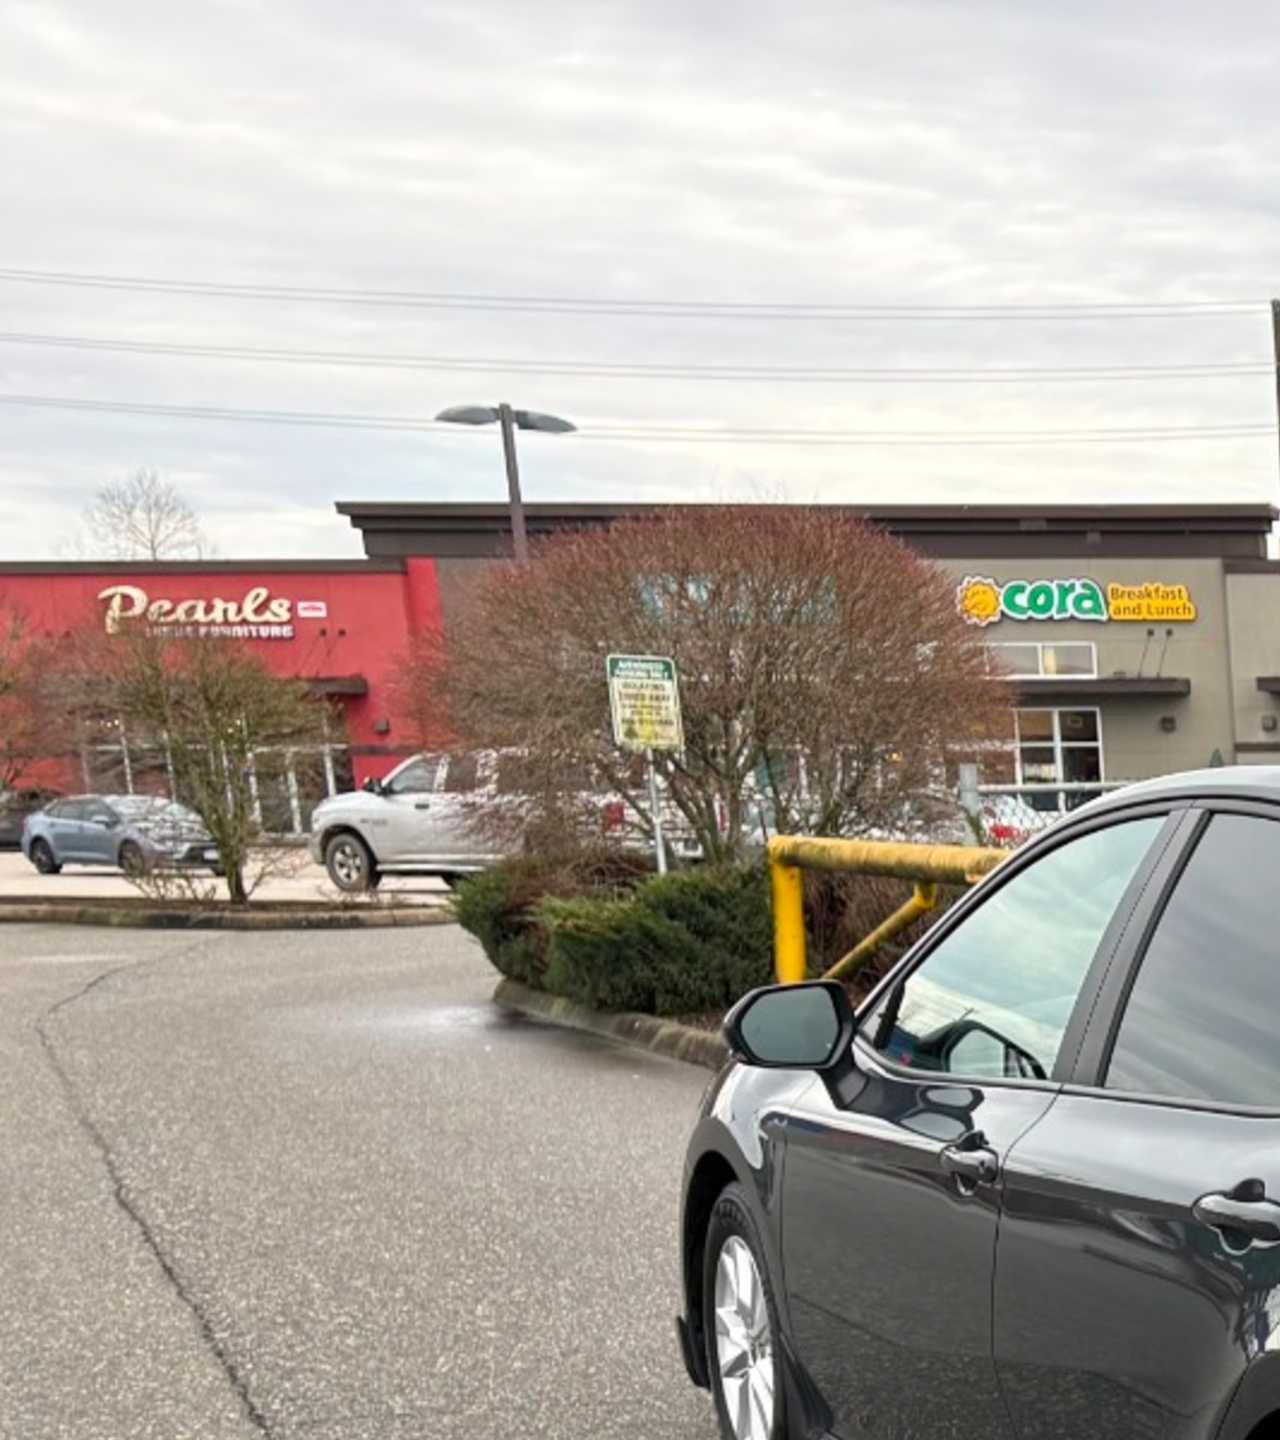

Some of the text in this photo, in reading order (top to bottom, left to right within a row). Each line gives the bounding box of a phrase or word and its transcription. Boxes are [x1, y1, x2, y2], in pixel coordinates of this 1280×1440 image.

[1002, 581, 1106, 616] cora
[1110, 585, 1185, 600] Breakfast
[97, 585, 292, 634] Pearls
[1113, 601, 1192, 616] and Lunch
